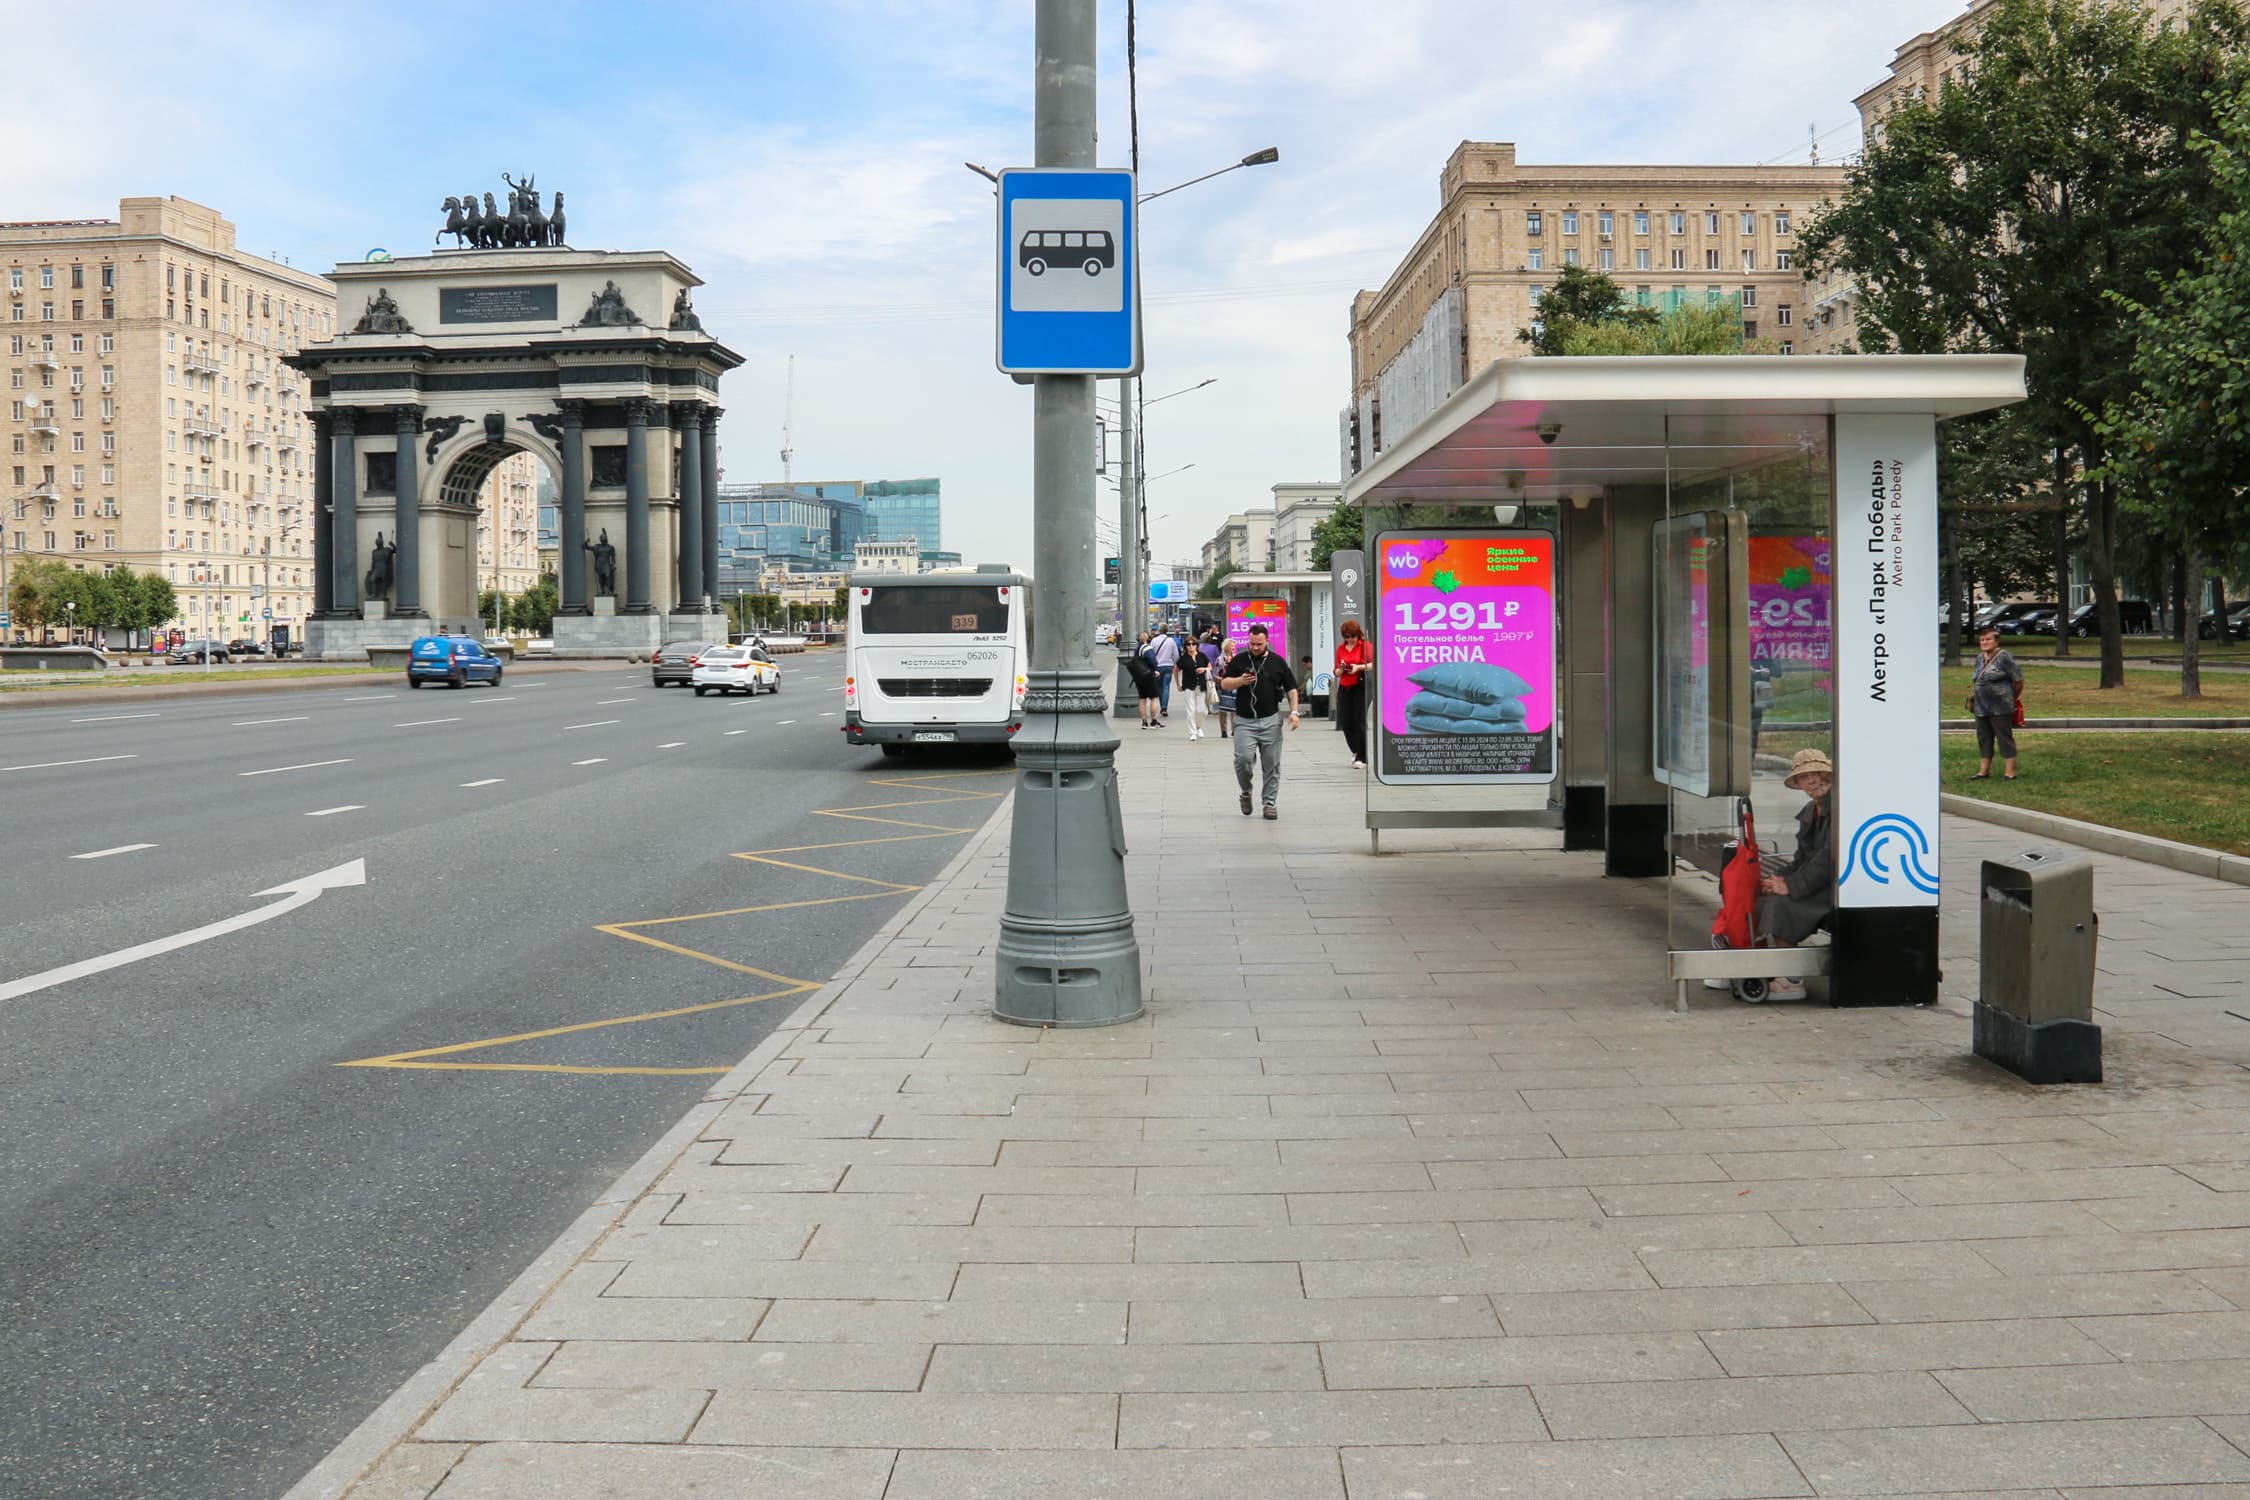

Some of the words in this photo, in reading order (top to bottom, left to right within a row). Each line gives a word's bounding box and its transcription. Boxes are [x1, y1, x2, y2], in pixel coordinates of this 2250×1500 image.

[1890, 458, 1903, 509] Pobedy
[1868, 459, 1886, 553] Победы»
[1891, 512, 1903, 544] Park
[1389, 552, 1419, 569] wb
[1487, 547, 1524, 557] Яркие
[1487, 564, 1520, 572] цены
[1892, 546, 1903, 587] Metro
[1869, 561, 1888, 625] «Парк
[953, 616, 974, 628] 339
[1394, 634, 1453, 644] Постельное
[1455, 633, 1485, 643] белье
[967, 651, 998, 661] 062026
[1395, 645, 1486, 664] YERRNA
[1870, 632, 1889, 702] Метро
